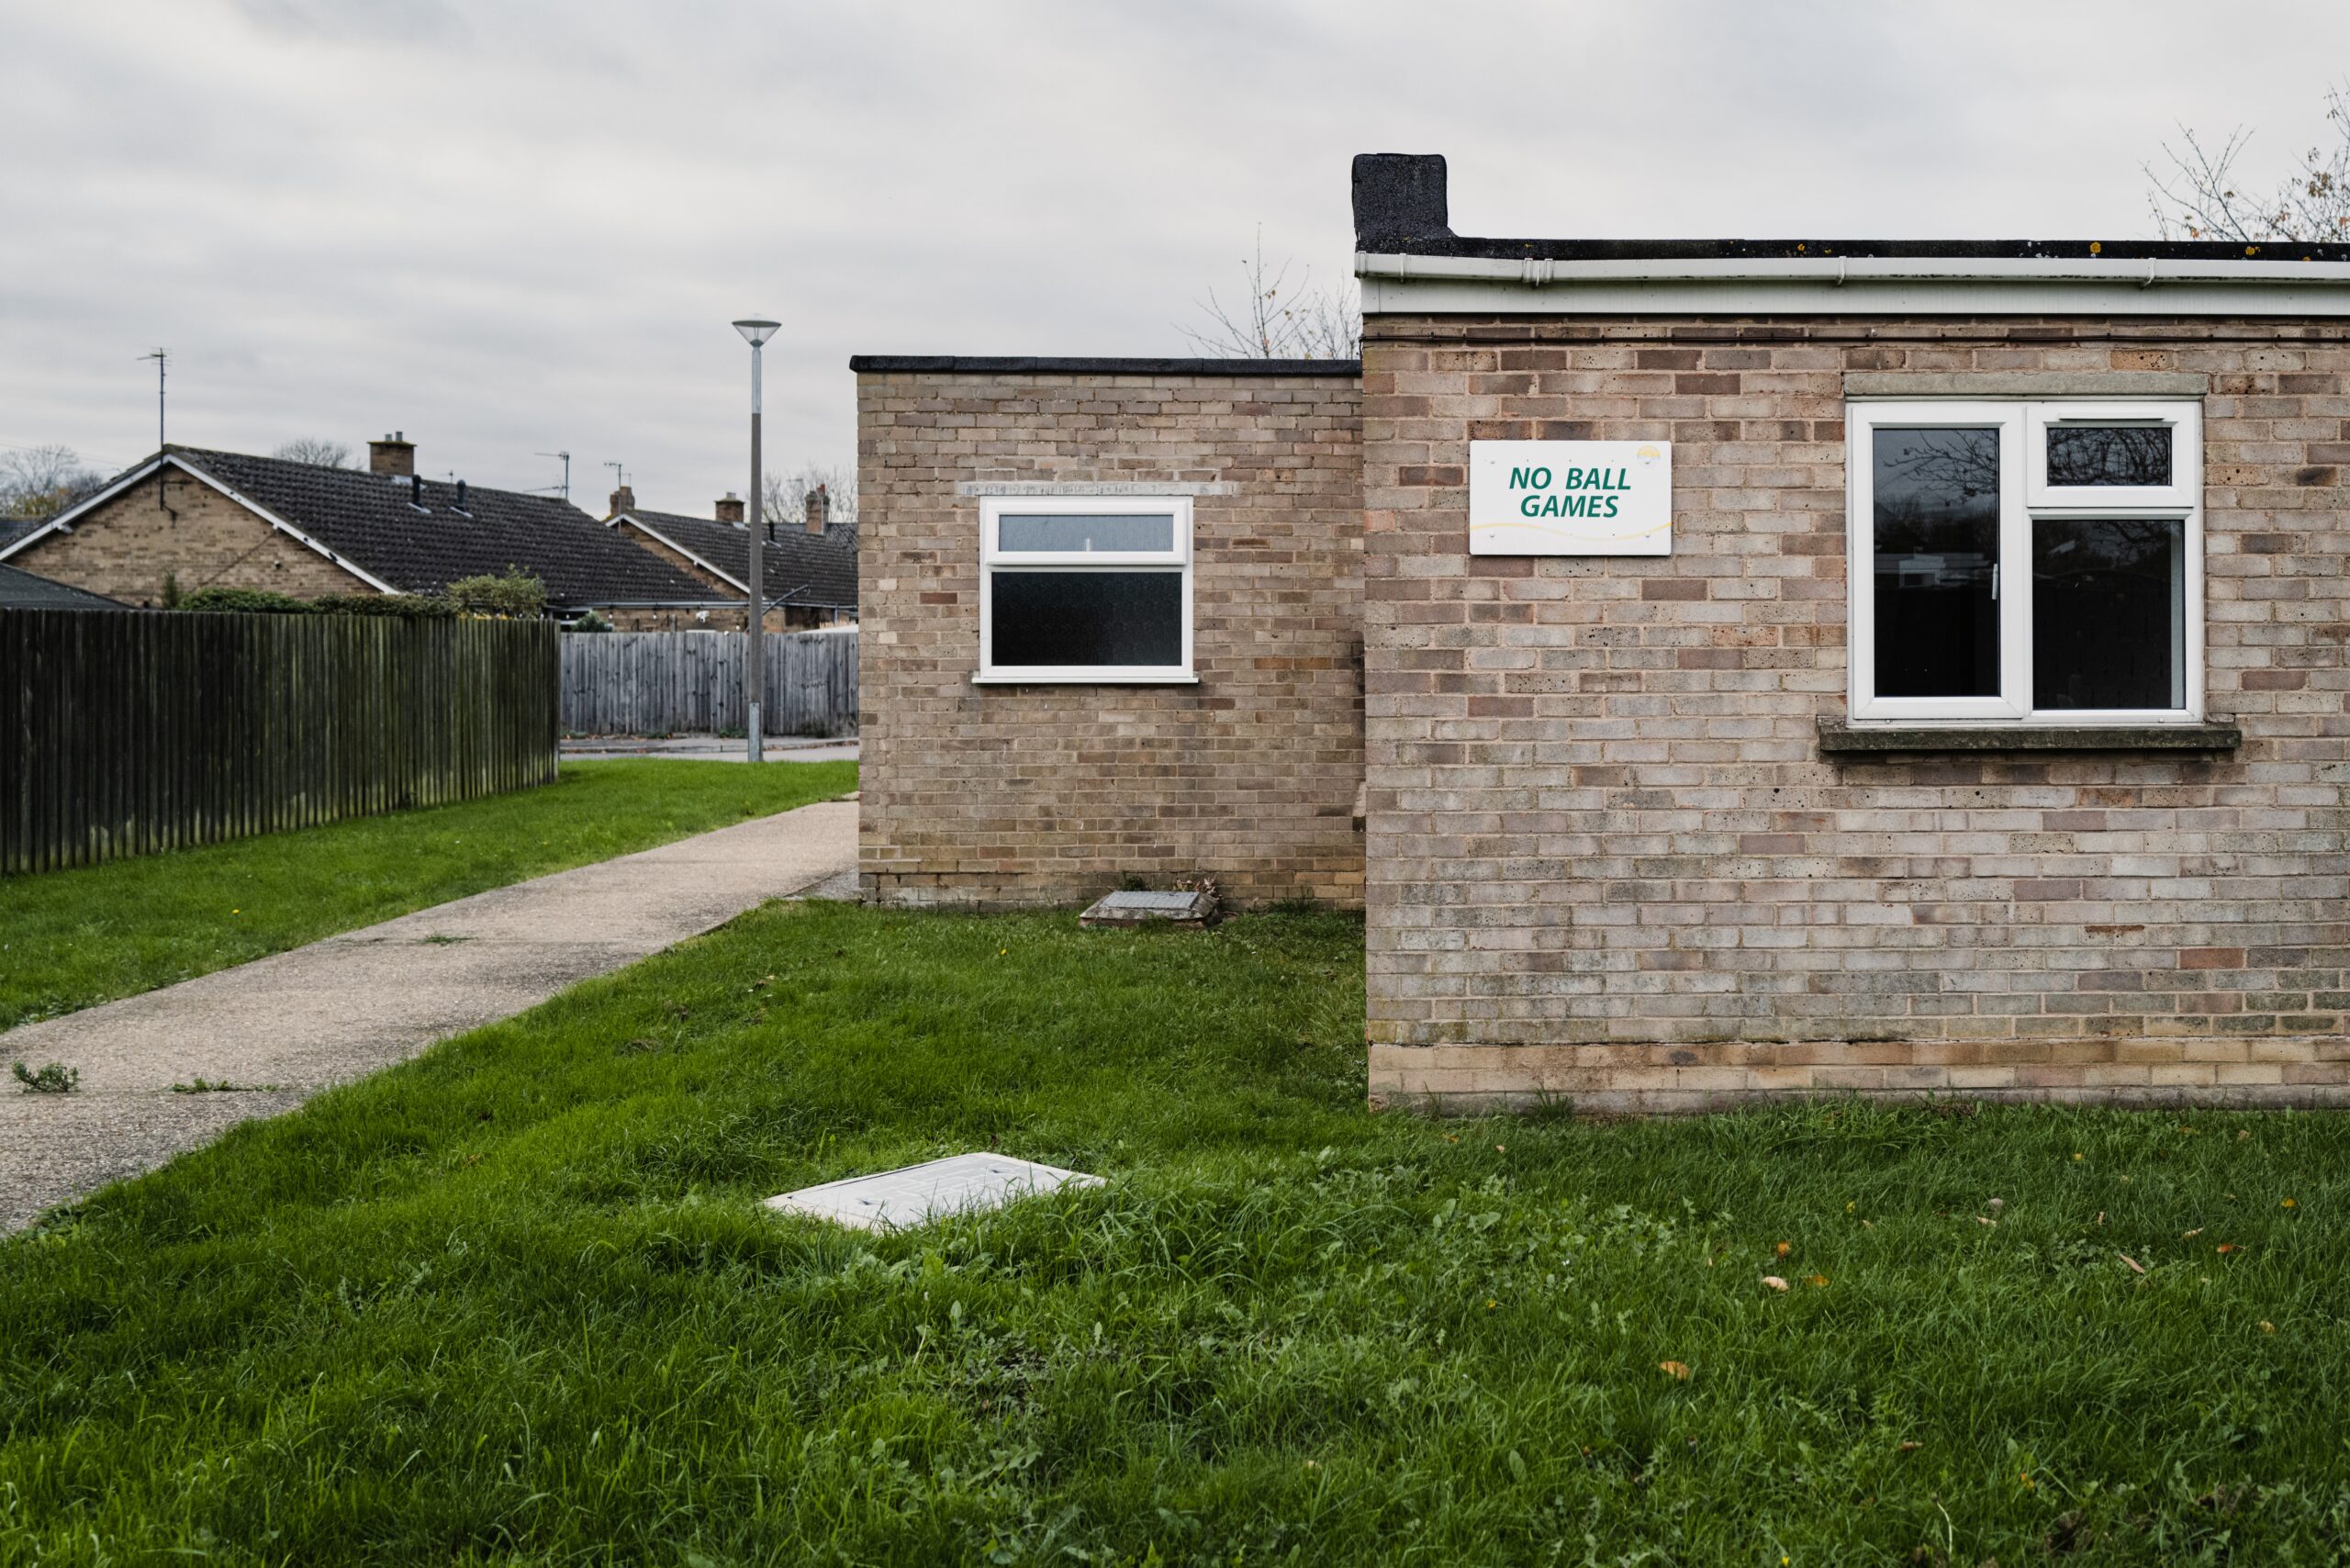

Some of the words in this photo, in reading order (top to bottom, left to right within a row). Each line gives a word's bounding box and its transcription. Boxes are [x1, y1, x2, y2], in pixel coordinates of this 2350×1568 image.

[1509, 467, 1552, 490] NO
[1565, 467, 1631, 490] BALL
[1520, 495, 1618, 518] GAMES
